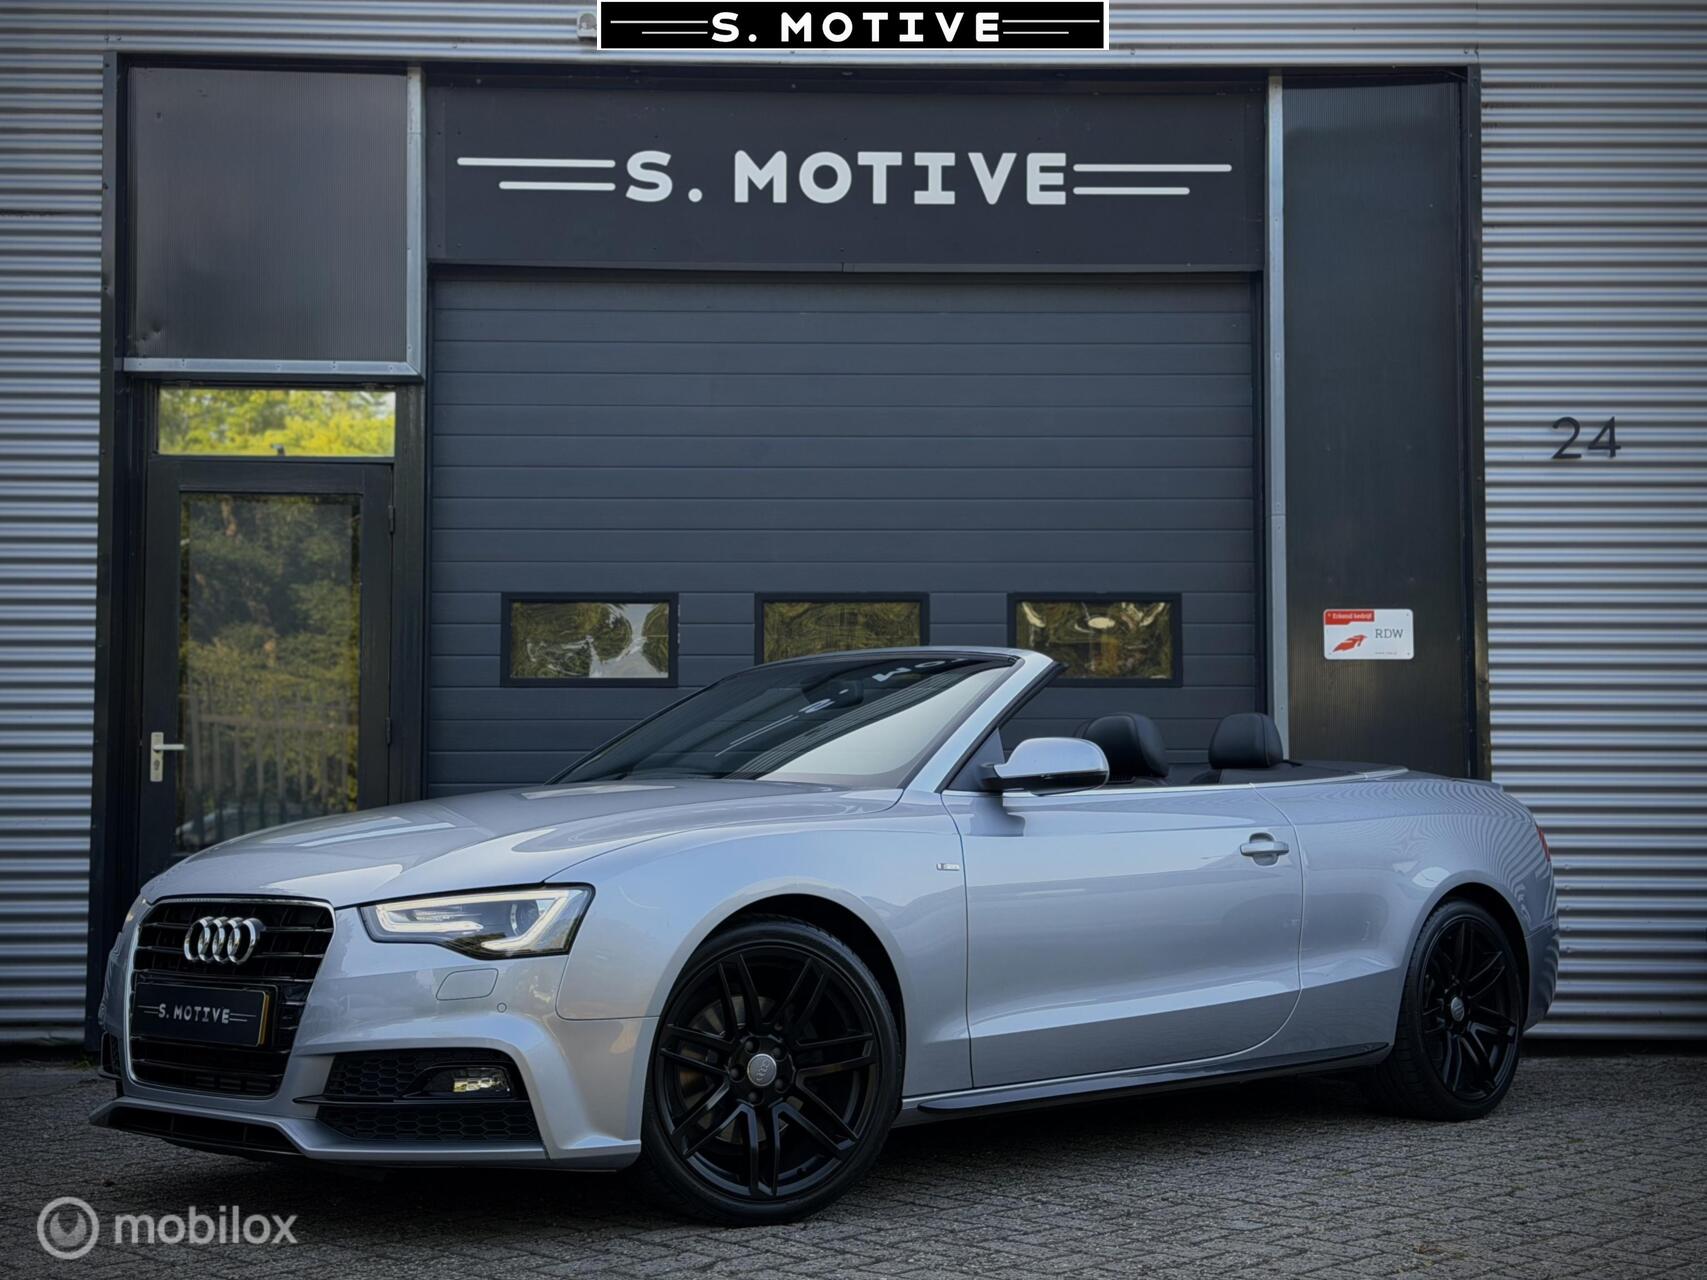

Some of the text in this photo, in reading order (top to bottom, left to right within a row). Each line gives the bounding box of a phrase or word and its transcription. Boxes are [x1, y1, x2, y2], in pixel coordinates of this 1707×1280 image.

[625, 150, 1067, 205] S. MOTIVE
[1552, 416, 1622, 459] 24
[1375, 628, 1404, 639] RDW
[158, 1003, 230, 1024] S. MOTIVE
